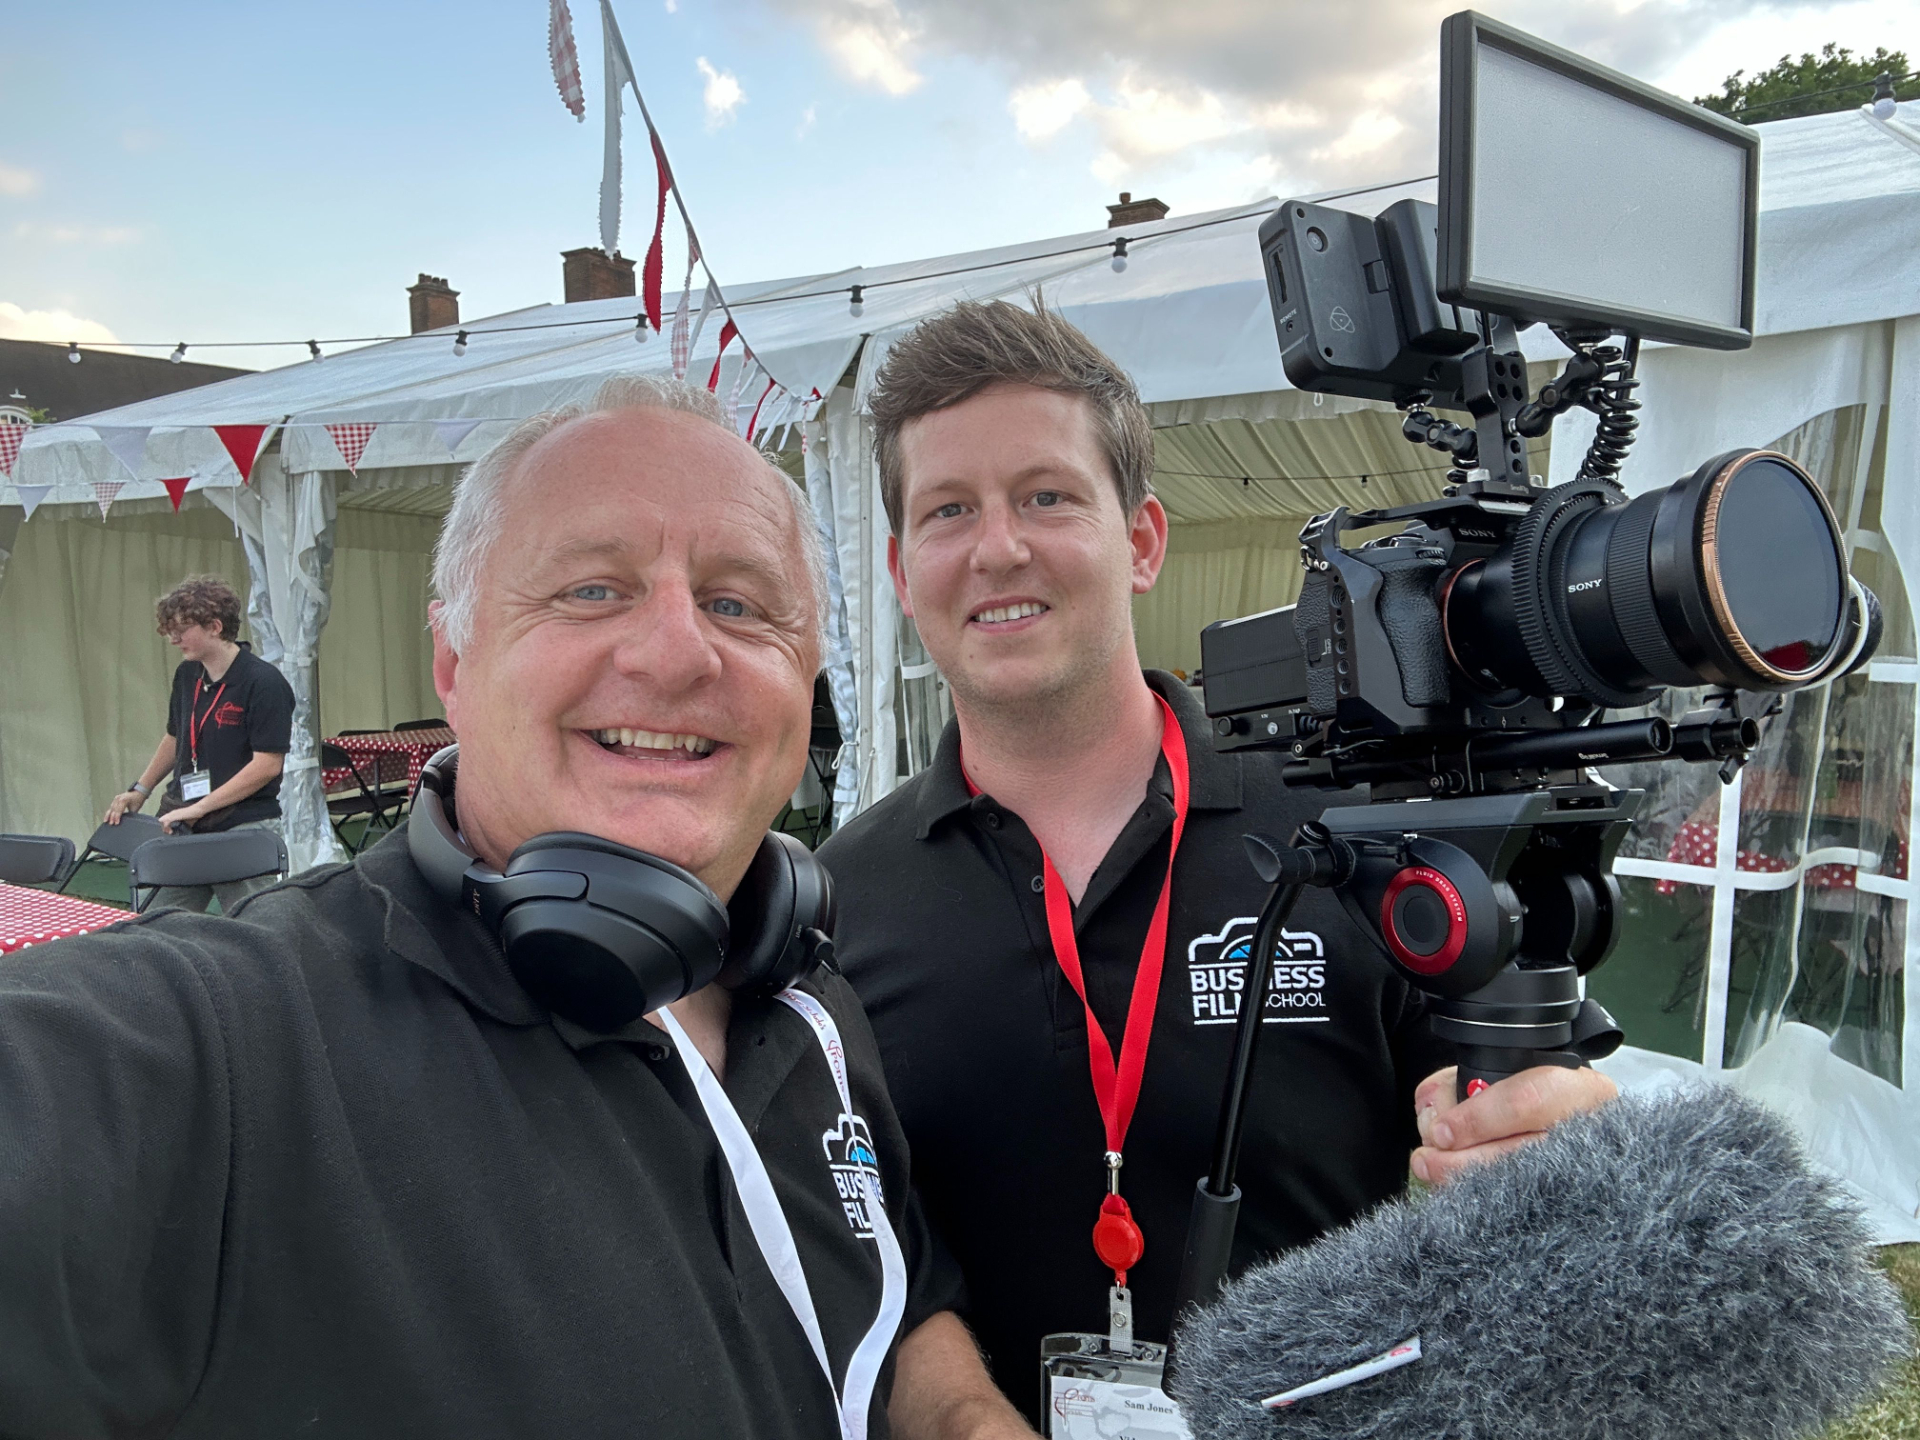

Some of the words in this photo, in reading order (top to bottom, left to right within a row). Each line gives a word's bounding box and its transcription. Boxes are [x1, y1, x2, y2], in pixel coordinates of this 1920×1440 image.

[1280, 309, 1297, 324] REMOTE
[1458, 528, 1497, 538] SONY
[1568, 578, 1602, 593] SONY
[1415, 870, 1434, 878] FLUID
[1434, 877, 1451, 892] DRAG
[1449, 893, 1463, 922] SYSTEM
[1190, 967, 1326, 992] BUSESS
[1124, 1400, 1145, 1410] Sam
[1147, 1403, 1174, 1414] Jones
